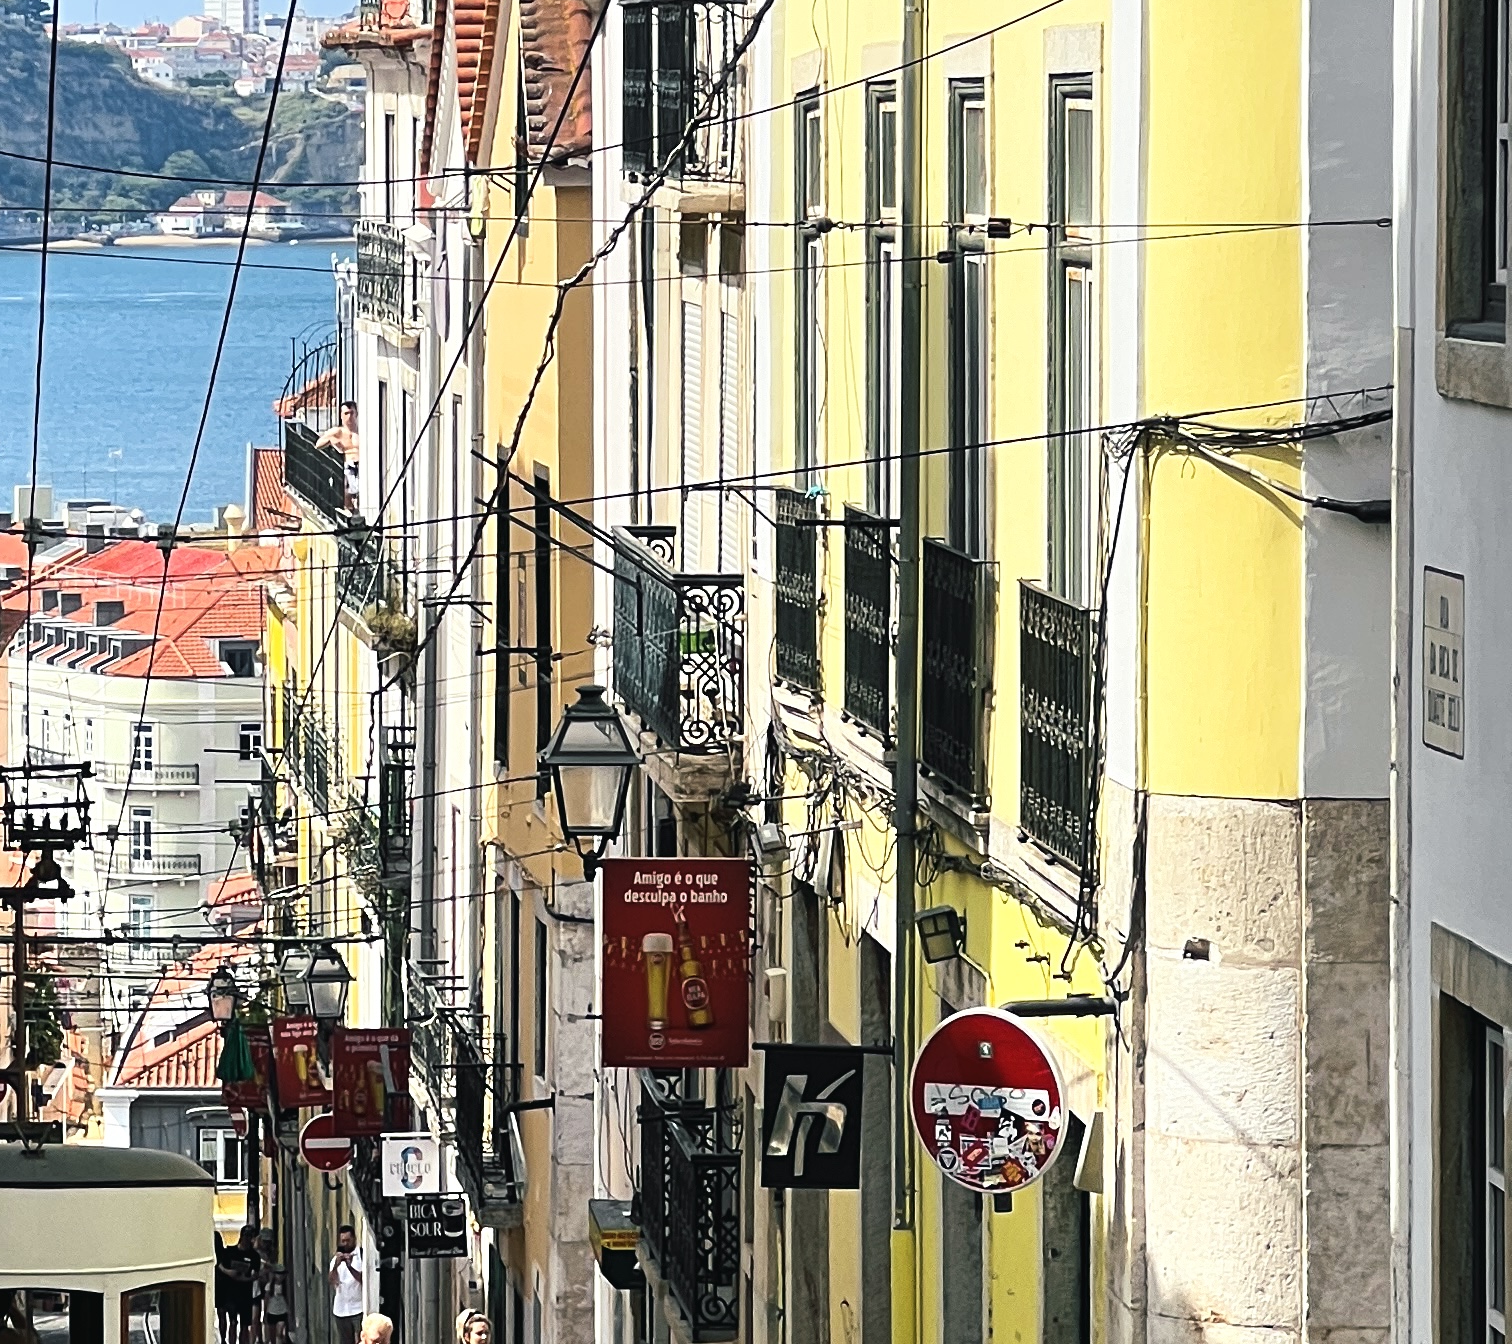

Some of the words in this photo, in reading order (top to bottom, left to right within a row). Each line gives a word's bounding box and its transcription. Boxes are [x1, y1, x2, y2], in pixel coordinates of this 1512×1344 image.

[633, 871, 671, 888] Amigo
[674, 871, 682, 885] é
[685, 873, 693, 885] o
[696, 874, 718, 888] que
[624, 889, 677, 906] desculpa
[680, 892, 688, 903] o
[690, 889, 728, 903] banho
[409, 1204, 438, 1218] BICA
[410, 1222, 442, 1237] SOUR
